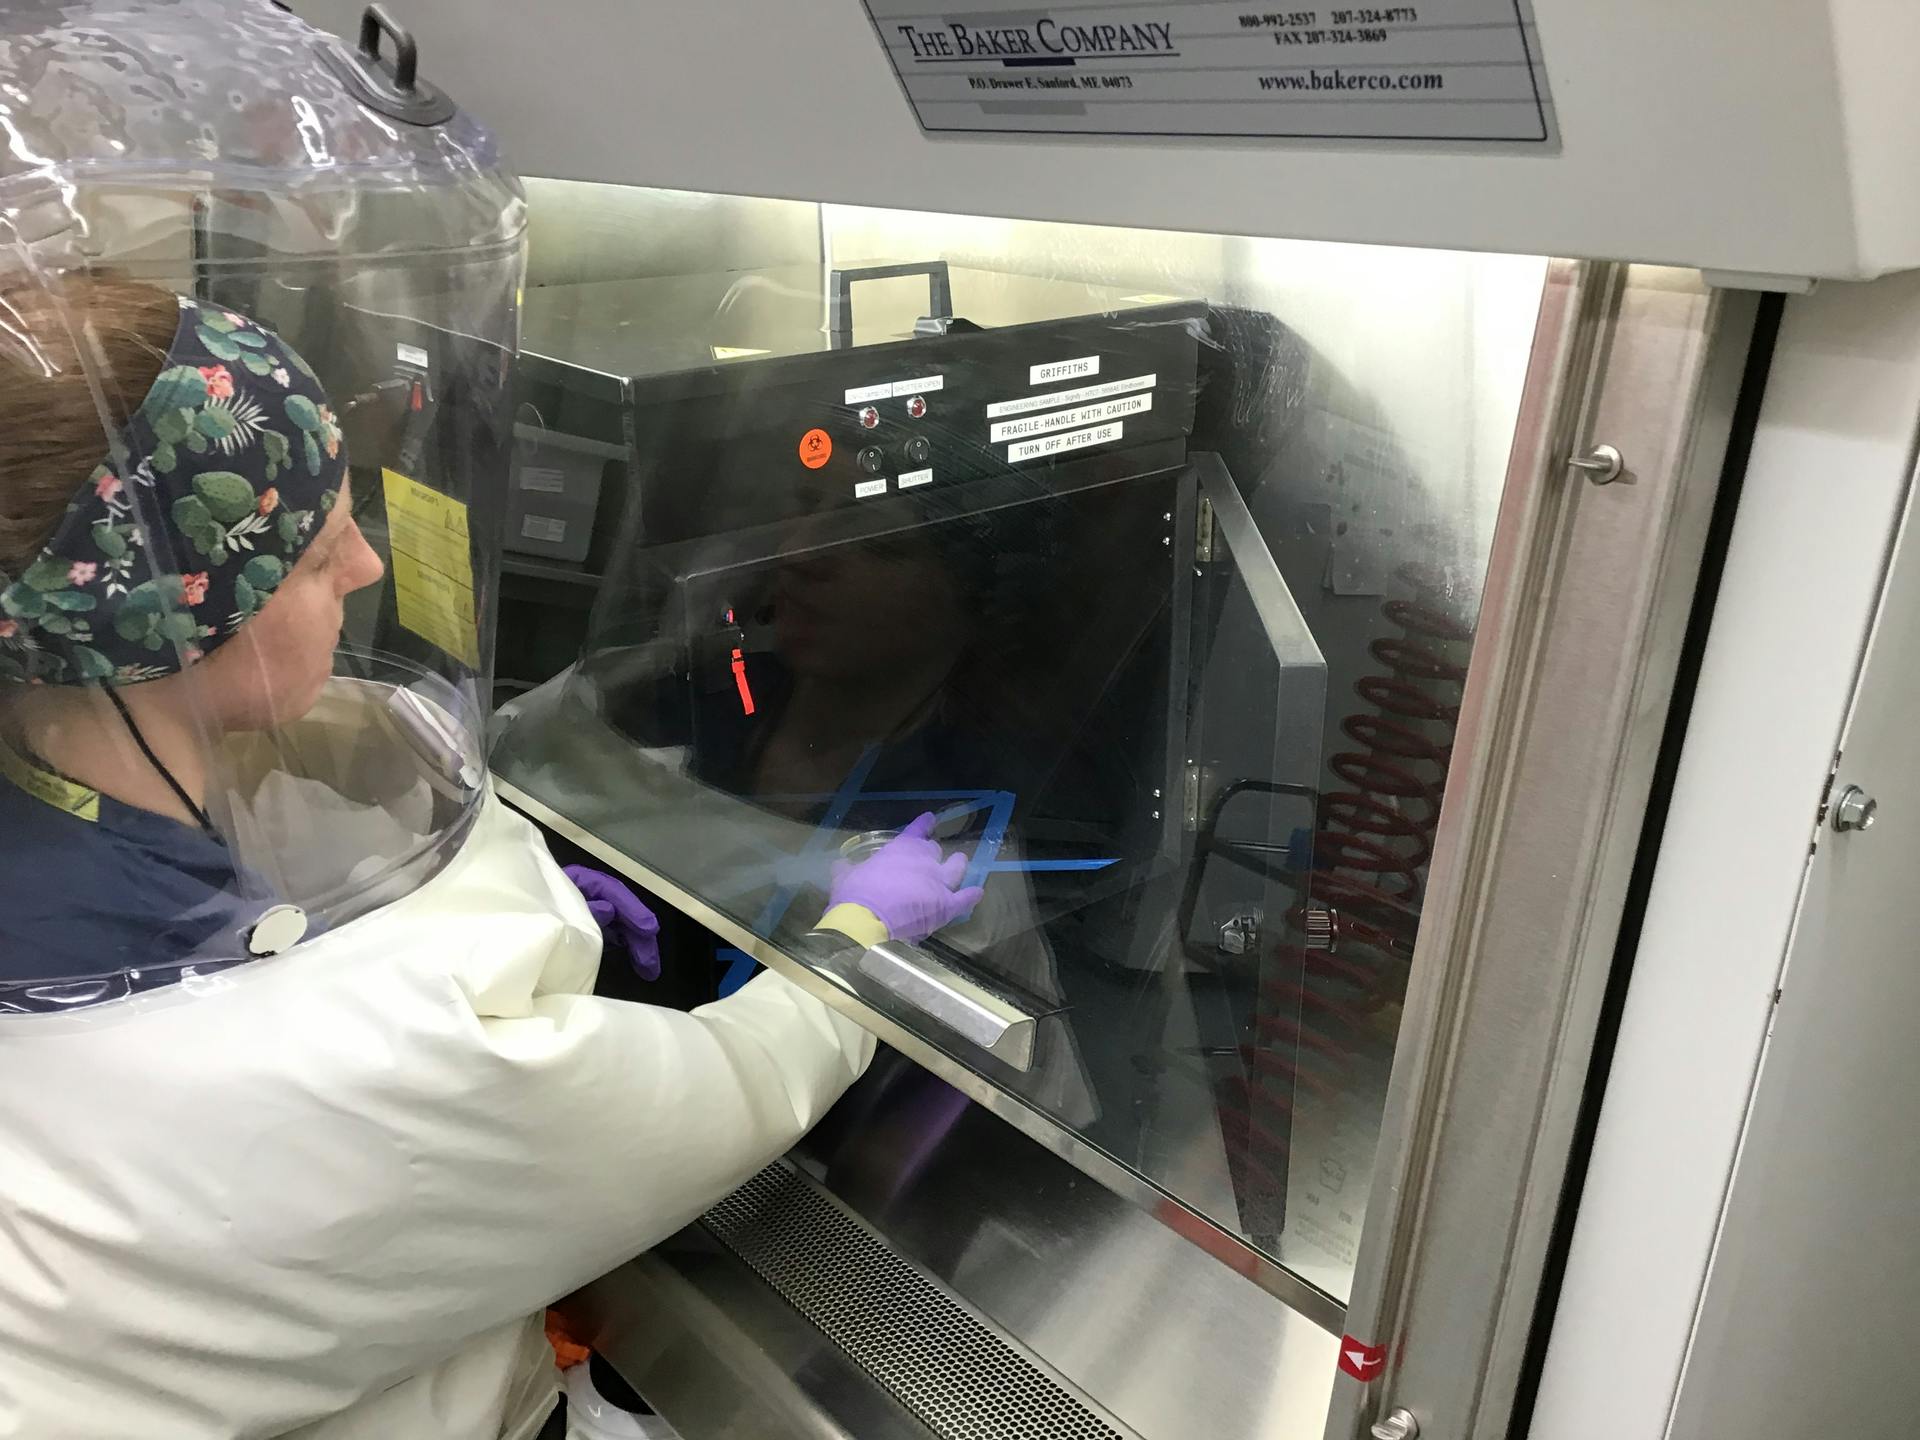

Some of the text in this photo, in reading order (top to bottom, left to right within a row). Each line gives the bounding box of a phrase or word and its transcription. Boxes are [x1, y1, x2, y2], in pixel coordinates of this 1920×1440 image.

[898, 18, 1174, 57] THE BAKER COMPANY
[1274, 28, 1387, 45] FAX 207-324-3869
[990, 77, 1023, 89] Drawer
[1258, 69, 1443, 90] www.bakerco.com
[1040, 362, 1089, 379] GRIFFITHS
[1001, 399, 1142, 437] FRAGILE-HANDLE WITH CAUTION
[1019, 427, 1112, 456] TURN OFF AFTER USE
